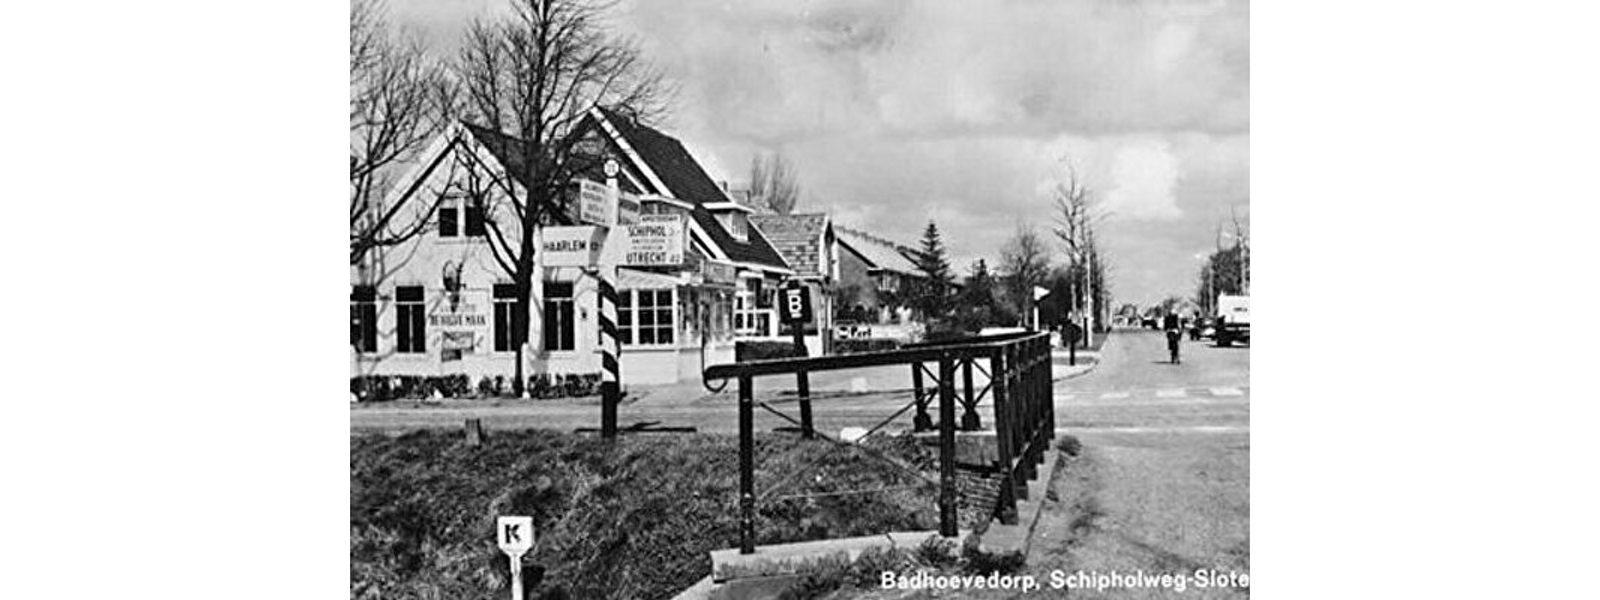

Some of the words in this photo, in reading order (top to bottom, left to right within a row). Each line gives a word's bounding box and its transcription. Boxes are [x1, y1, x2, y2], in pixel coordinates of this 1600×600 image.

[628, 225, 666, 237] SCHIPHOL
[543, 240, 587, 251] HAARLEM
[626, 252, 667, 263] UTRECHT
[789, 295, 802, 313] B
[505, 524, 521, 543] K
